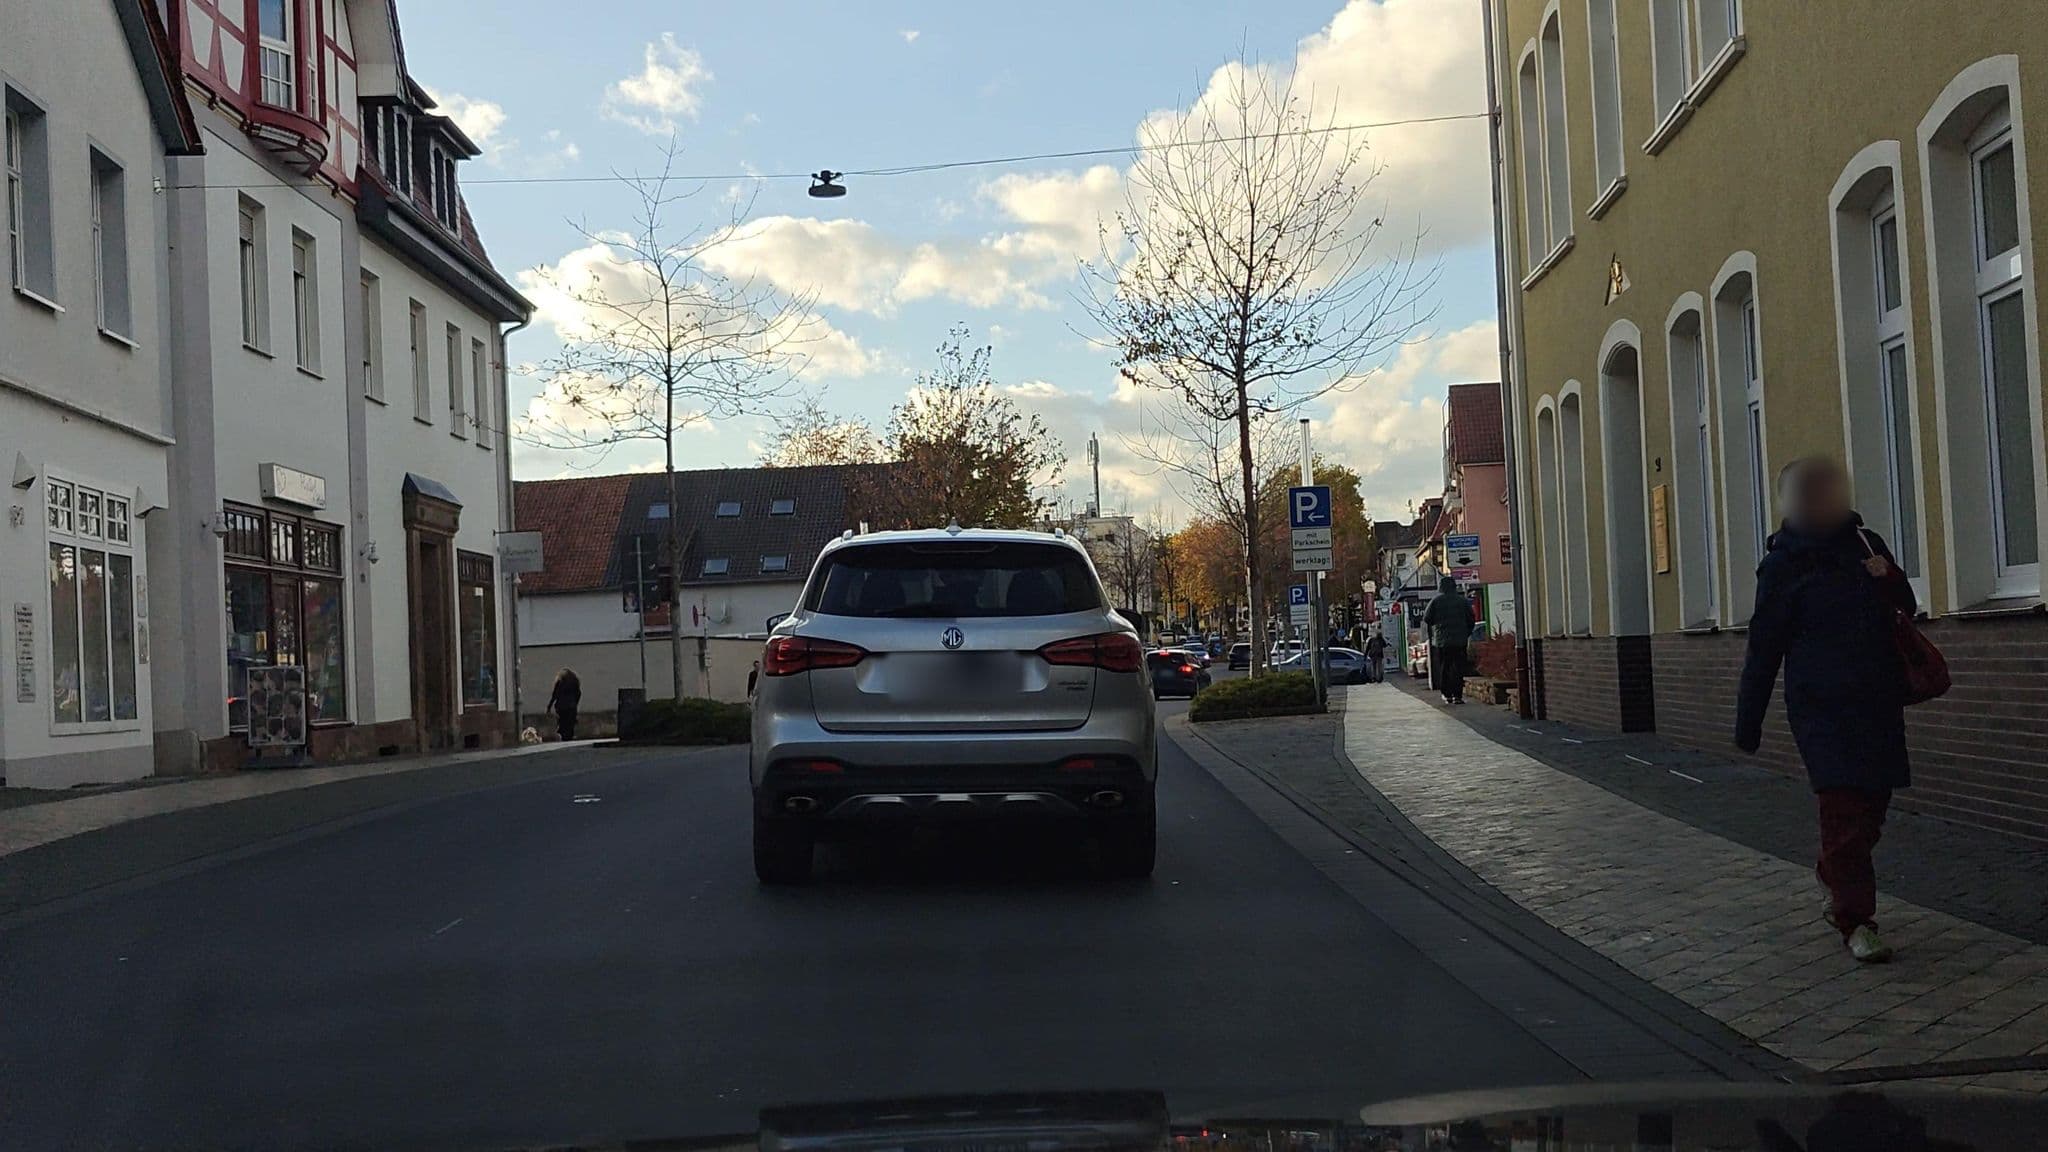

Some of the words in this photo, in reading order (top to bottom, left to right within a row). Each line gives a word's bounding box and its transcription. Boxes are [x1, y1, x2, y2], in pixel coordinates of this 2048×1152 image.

[1295, 492, 1318, 523] P
[1294, 538, 1330, 546] Parkschein
[1292, 588, 1303, 604] P
[943, 629, 962, 646] MG
